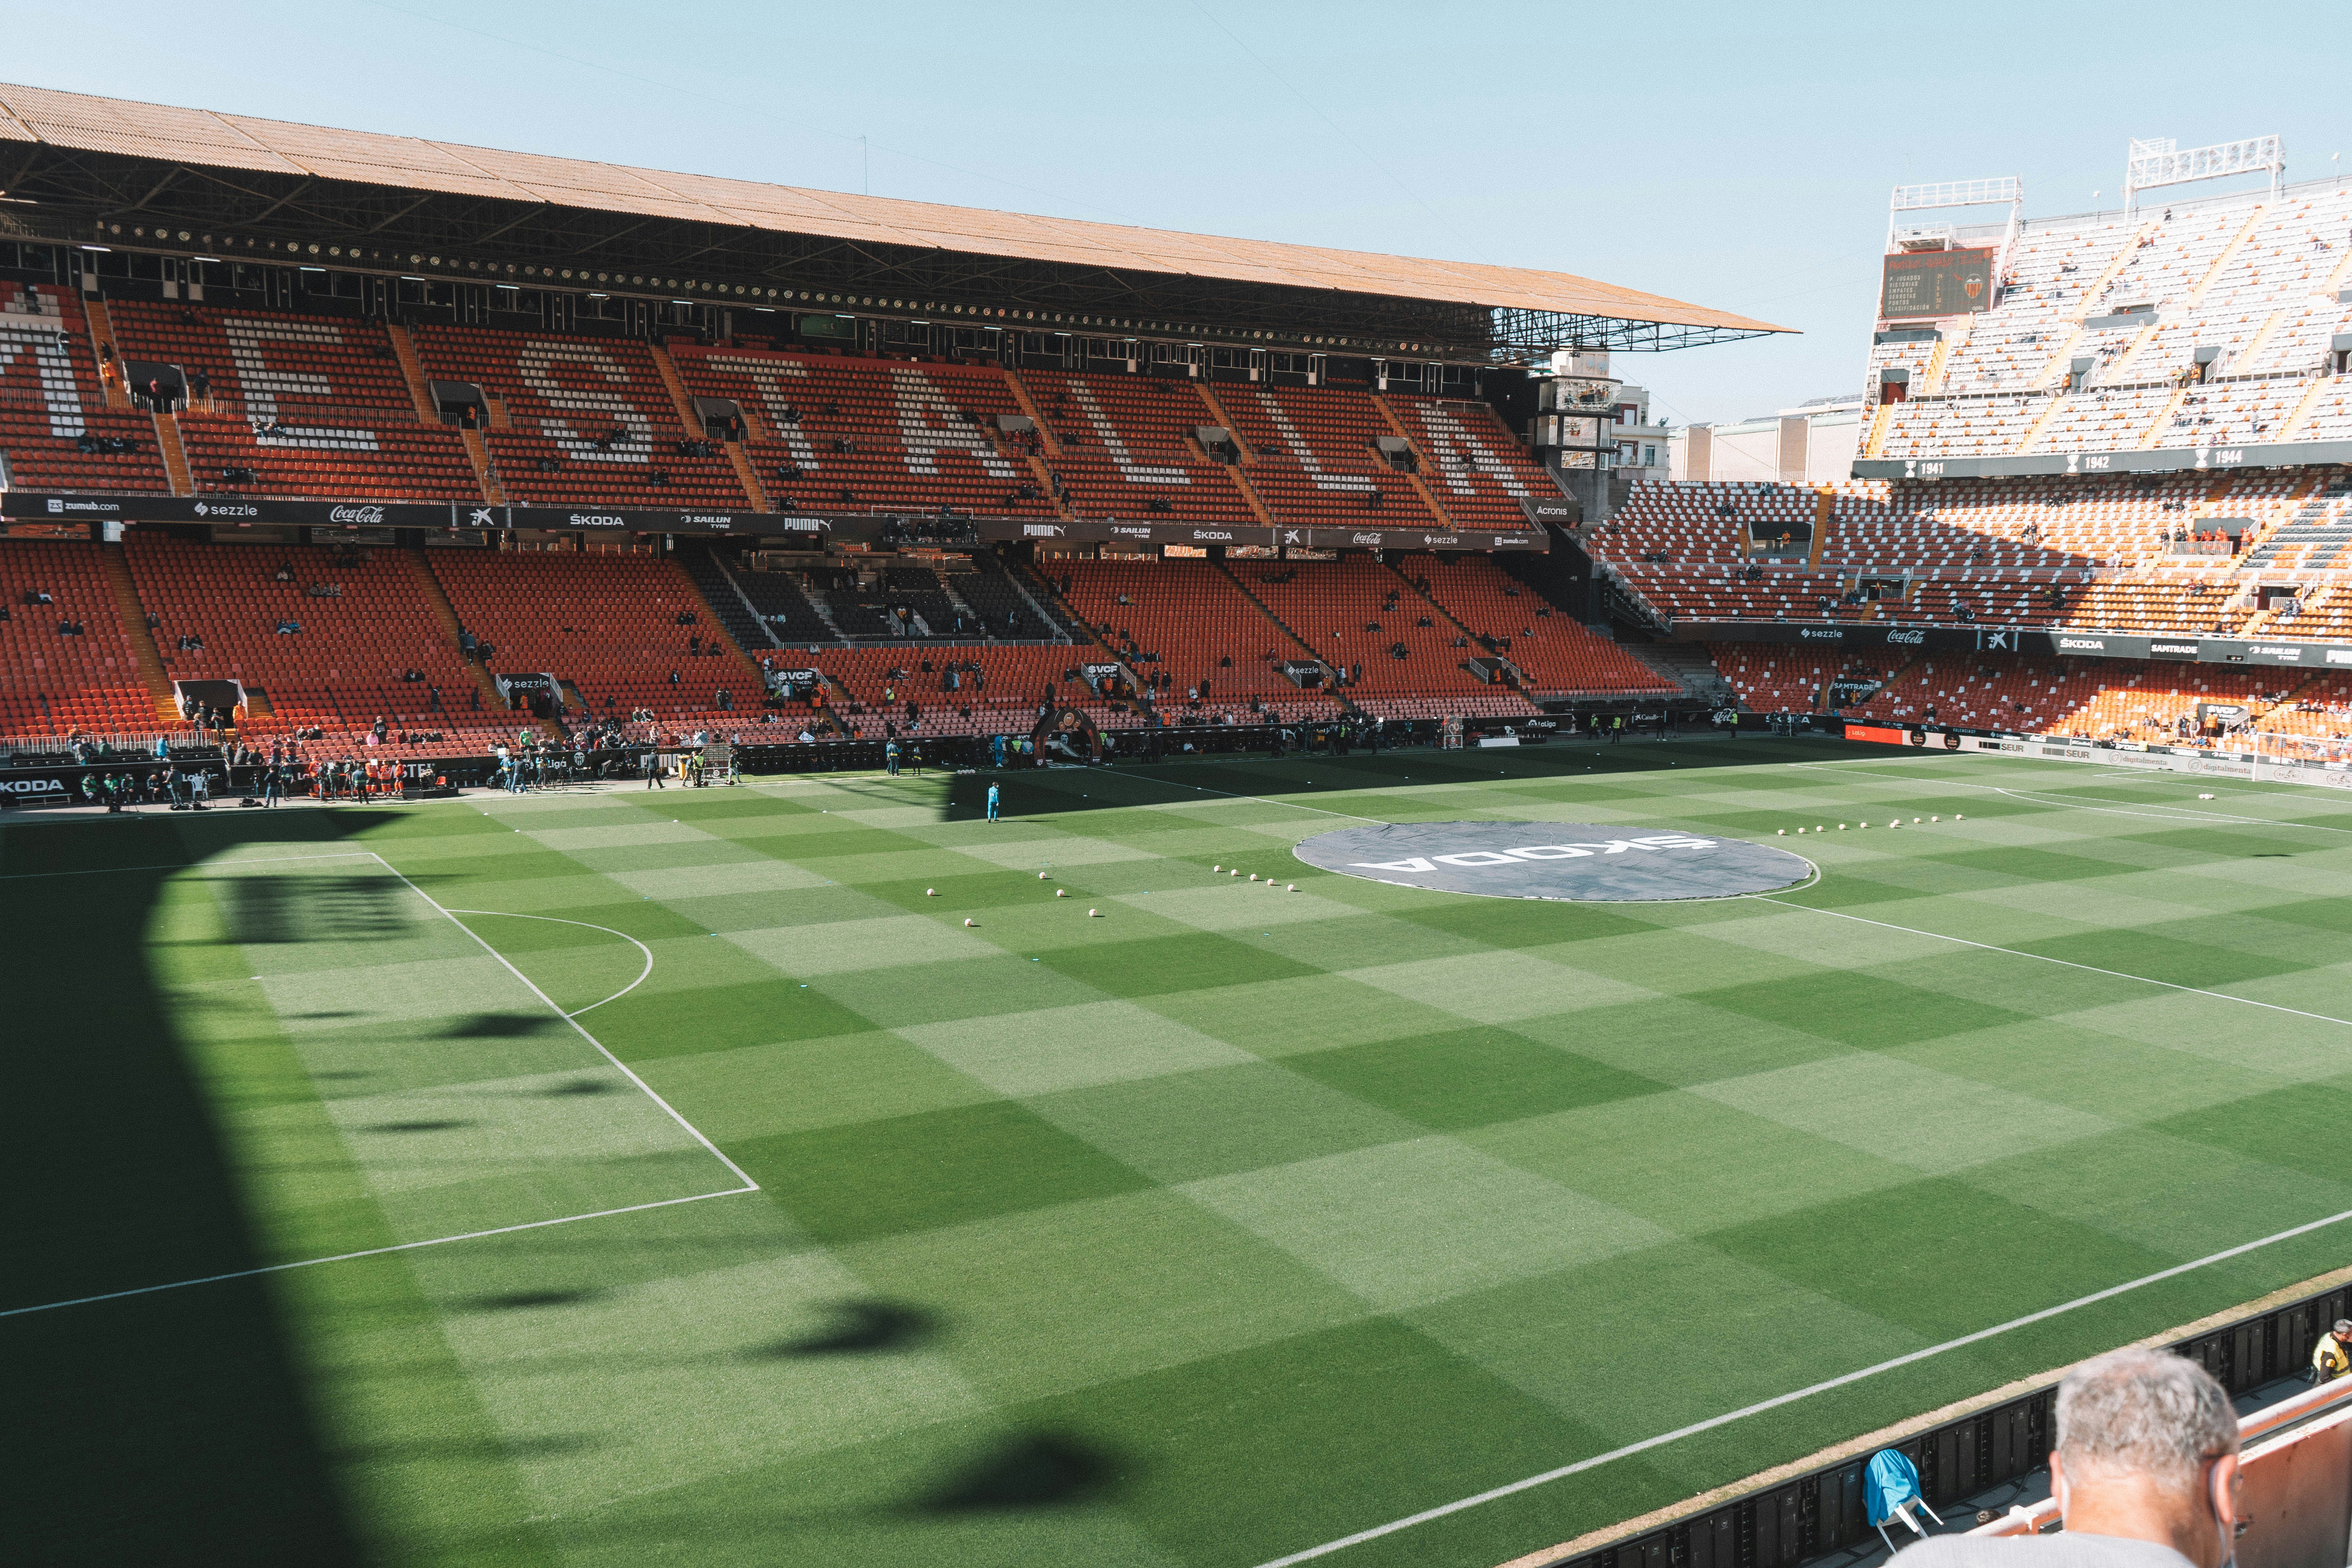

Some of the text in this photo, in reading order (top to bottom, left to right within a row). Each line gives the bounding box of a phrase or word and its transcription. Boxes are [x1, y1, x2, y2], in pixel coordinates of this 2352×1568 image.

[2085, 456, 2110, 469] 1942
[2215, 450, 2243, 464] 1944
[1921, 463, 1944, 474] 1941
[65, 501, 119, 511] zumub.com
[211, 503, 258, 516] sezzle
[1537, 506, 1567, 515] Acronis
[570, 514, 624, 526] ŠKODA
[785, 518, 819, 531] PUMA
[1024, 524, 1054, 537] PUMA
[1194, 530, 1232, 540] ŠKODA
[1433, 536, 1458, 544] sezzle
[1811, 630, 1843, 638] sezzle
[2060, 638, 2104, 650] ŠKODA
[2151, 644, 2198, 654] SAMTRADE
[2261, 647, 2301, 655] SAILUN
[514, 678, 549, 689] sezzle
[1834, 682, 1874, 690] SAMTRADE
[2001, 743, 2024, 752] SEUR
[2066, 749, 2089, 759] SEUR
[641, 754, 681, 768] PMA
[2123, 755, 2167, 766] digitalmenta
[2203, 764, 2250, 774] digitalmenta
[0, 780, 65, 793] KODA
[1347, 835, 1719, 873] ŠKODA
